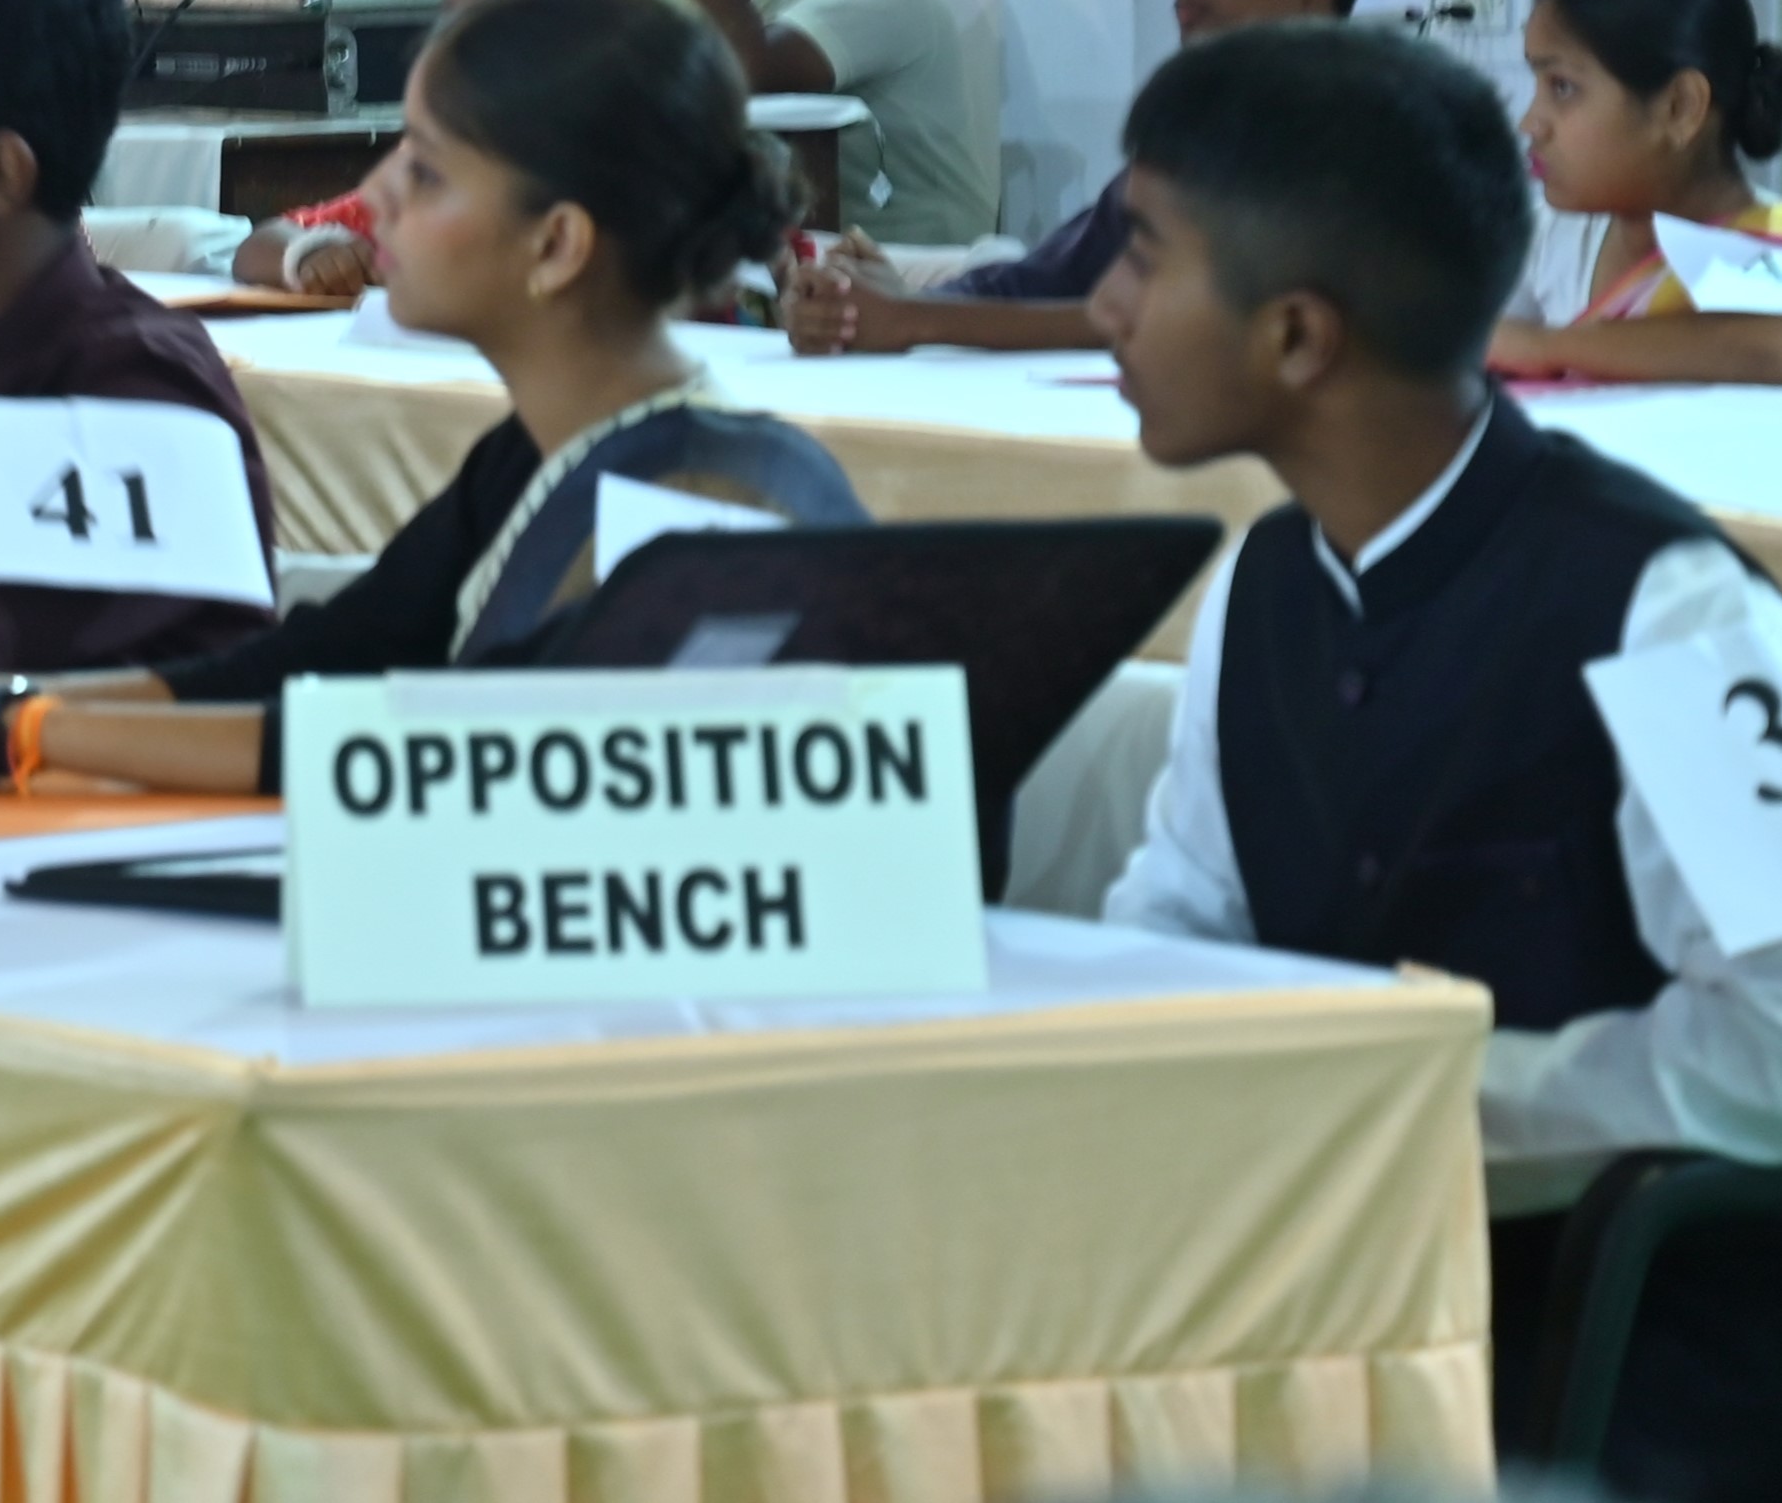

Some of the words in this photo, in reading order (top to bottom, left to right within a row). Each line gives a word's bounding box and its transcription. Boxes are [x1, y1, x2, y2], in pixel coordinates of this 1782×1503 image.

[29, 461, 164, 548] 41
[332, 718, 931, 820] OPPOSITION
[471, 865, 807, 959] BENCH
